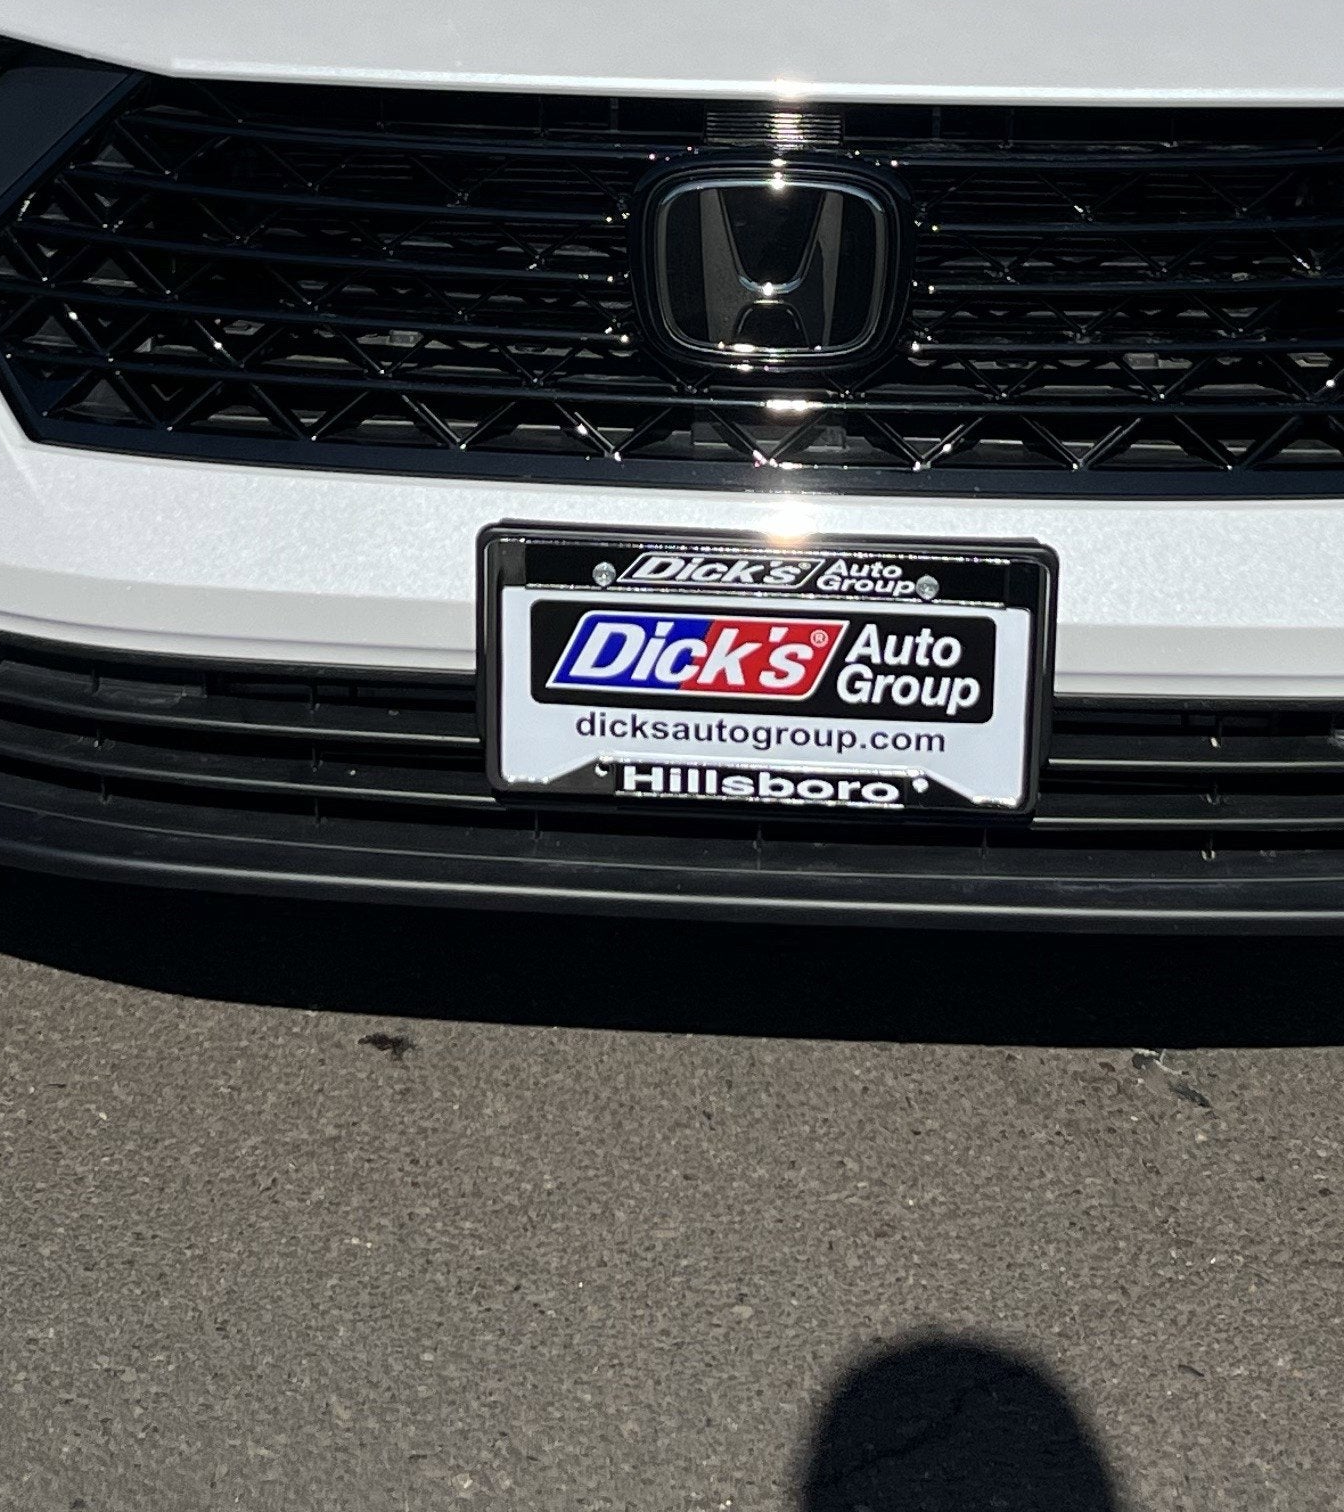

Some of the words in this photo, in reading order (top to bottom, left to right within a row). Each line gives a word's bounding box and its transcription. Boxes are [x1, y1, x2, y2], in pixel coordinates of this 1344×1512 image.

[816, 574, 917, 598] Group
[824, 558, 903, 578] Auto
[844, 623, 963, 667] Auto
[836, 664, 981, 716] Group
[575, 710, 946, 754] dicksautogroup.com
[622, 765, 901, 804] Hillsboro
